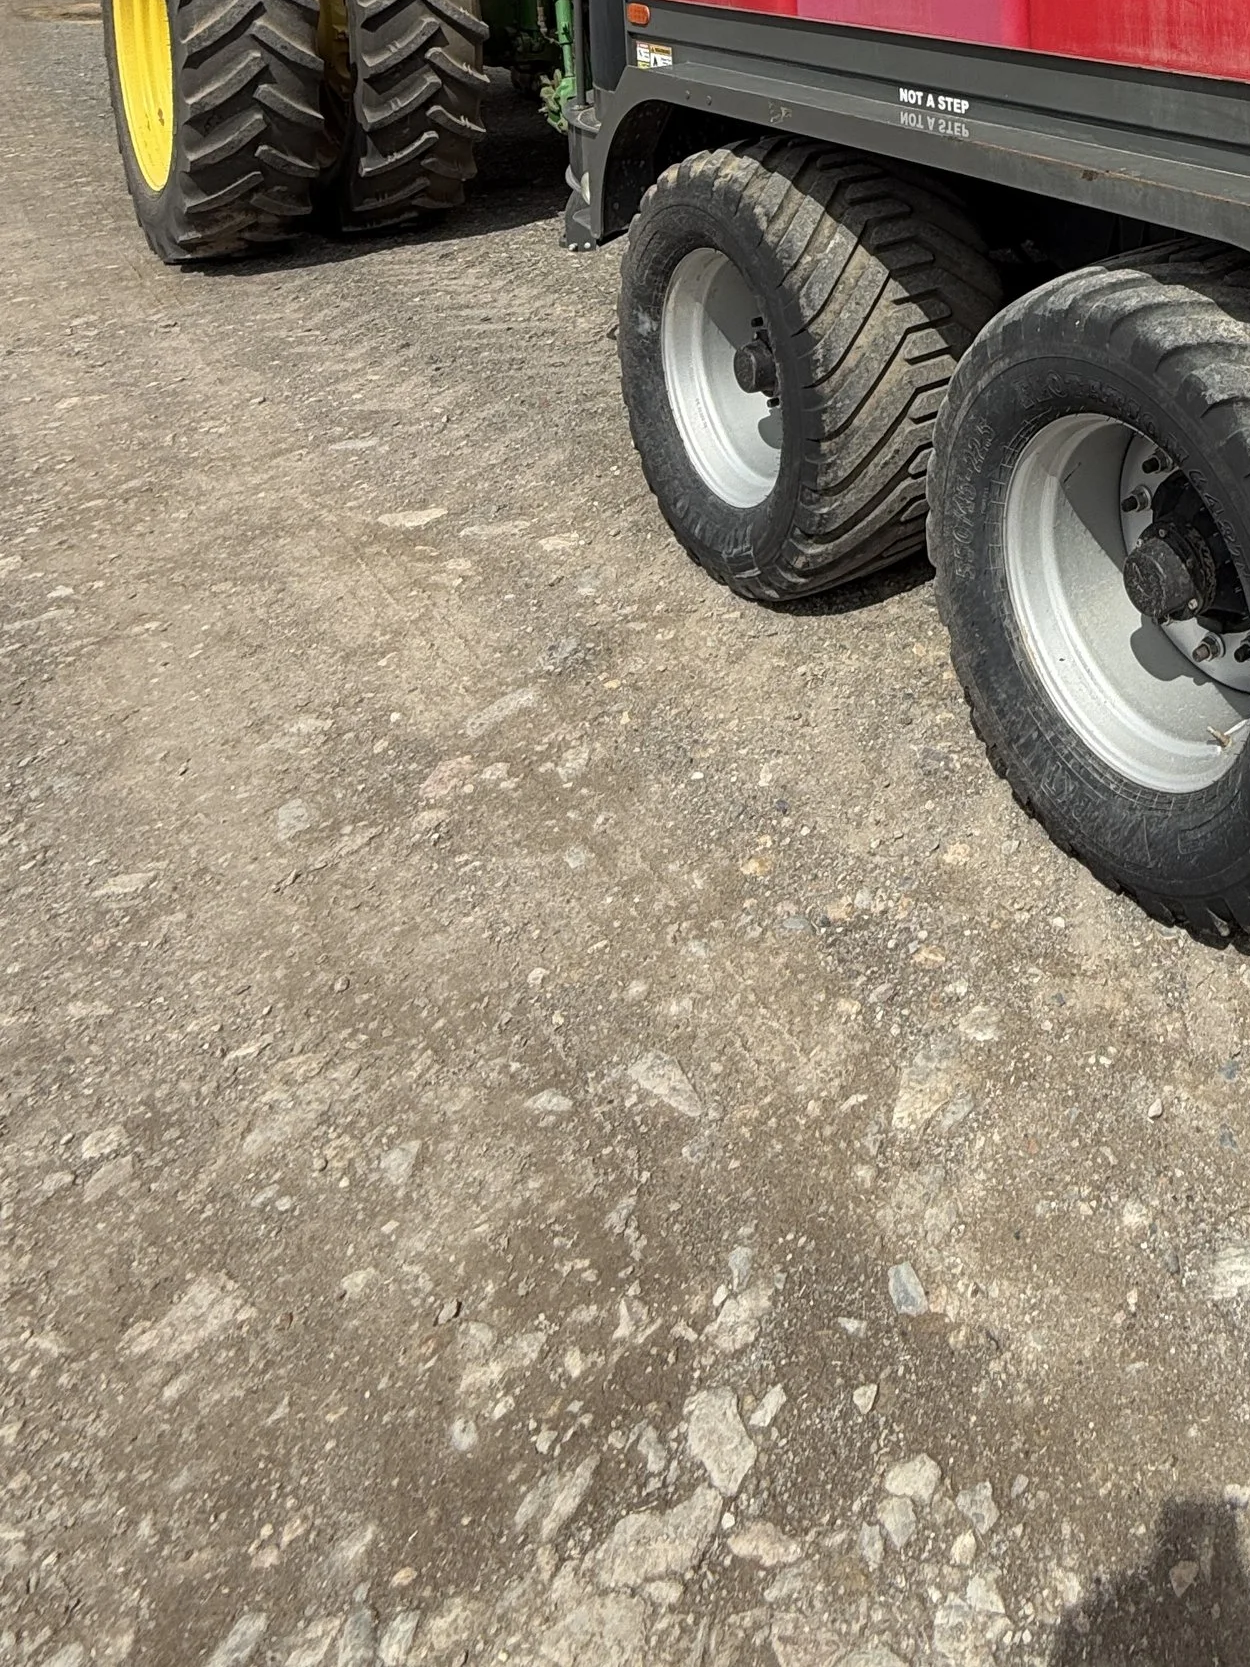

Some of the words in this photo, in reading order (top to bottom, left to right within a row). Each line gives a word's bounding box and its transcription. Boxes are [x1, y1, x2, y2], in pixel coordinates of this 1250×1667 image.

[899, 87, 923, 105] NOT
[926, 94, 935, 108] A
[938, 95, 969, 114] STEP
